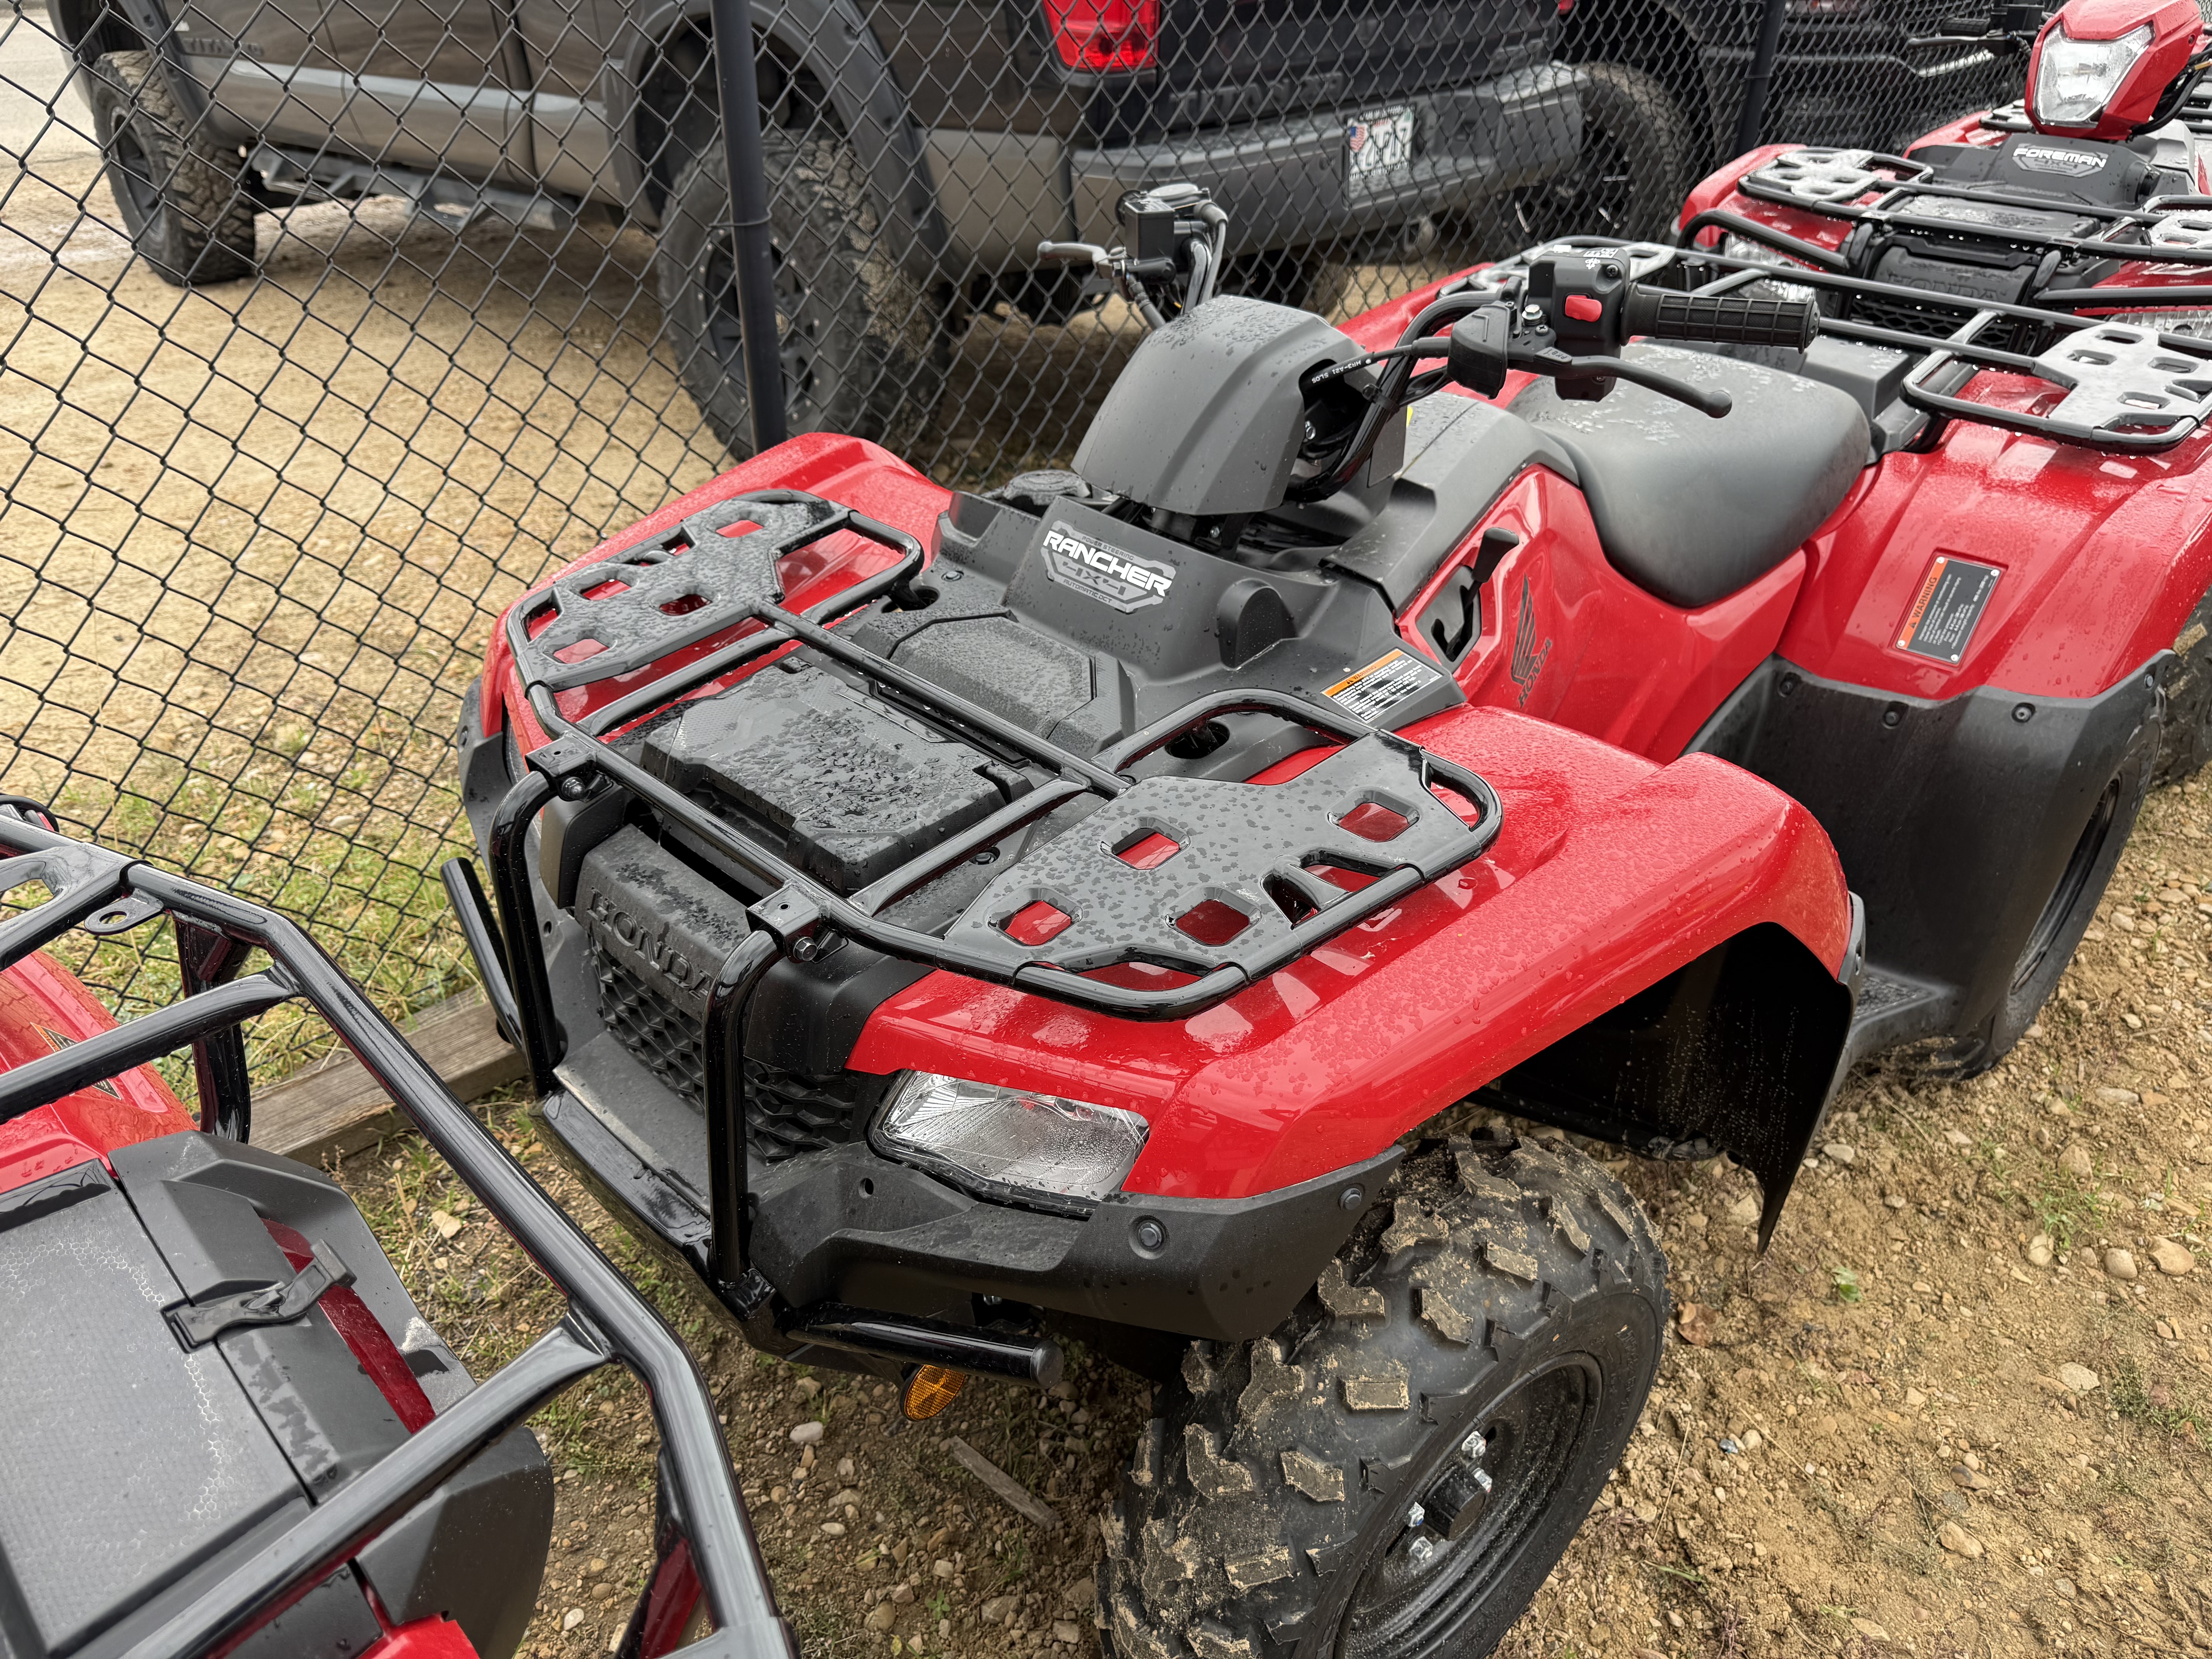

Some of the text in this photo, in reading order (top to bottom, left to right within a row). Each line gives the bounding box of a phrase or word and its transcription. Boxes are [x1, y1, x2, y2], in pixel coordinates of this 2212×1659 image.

[2013, 148, 2107, 168] FOREMAN
[1043, 530, 1172, 597] RANCHER
[1082, 536, 1134, 561] POWER STEERING
[1063, 561, 1127, 596] 4X4
[1063, 579, 1113, 603] AUTOMATIC DCT
[1912, 577, 1937, 618] WARNING
[1352, 665, 1377, 680] WARNING
[1518, 637, 1553, 710] HONDA
[586, 886, 715, 1000] HONDA
